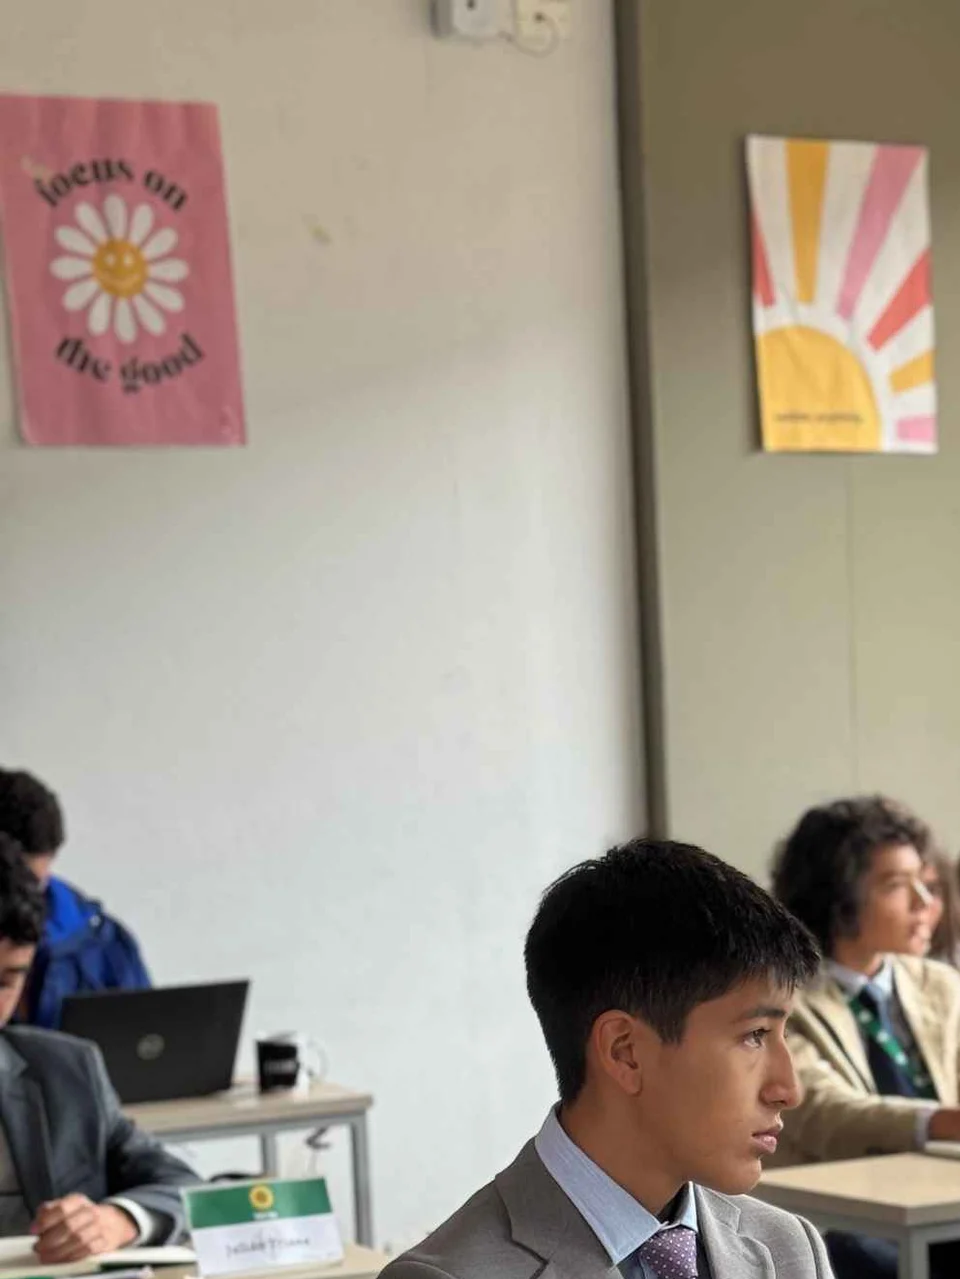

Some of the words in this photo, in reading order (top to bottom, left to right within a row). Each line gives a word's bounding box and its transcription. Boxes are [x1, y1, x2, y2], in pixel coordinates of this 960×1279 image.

[34, 157, 136, 208] focus
[144, 168, 189, 213] on
[54, 334, 112, 382] the
[120, 332, 205, 395] good
